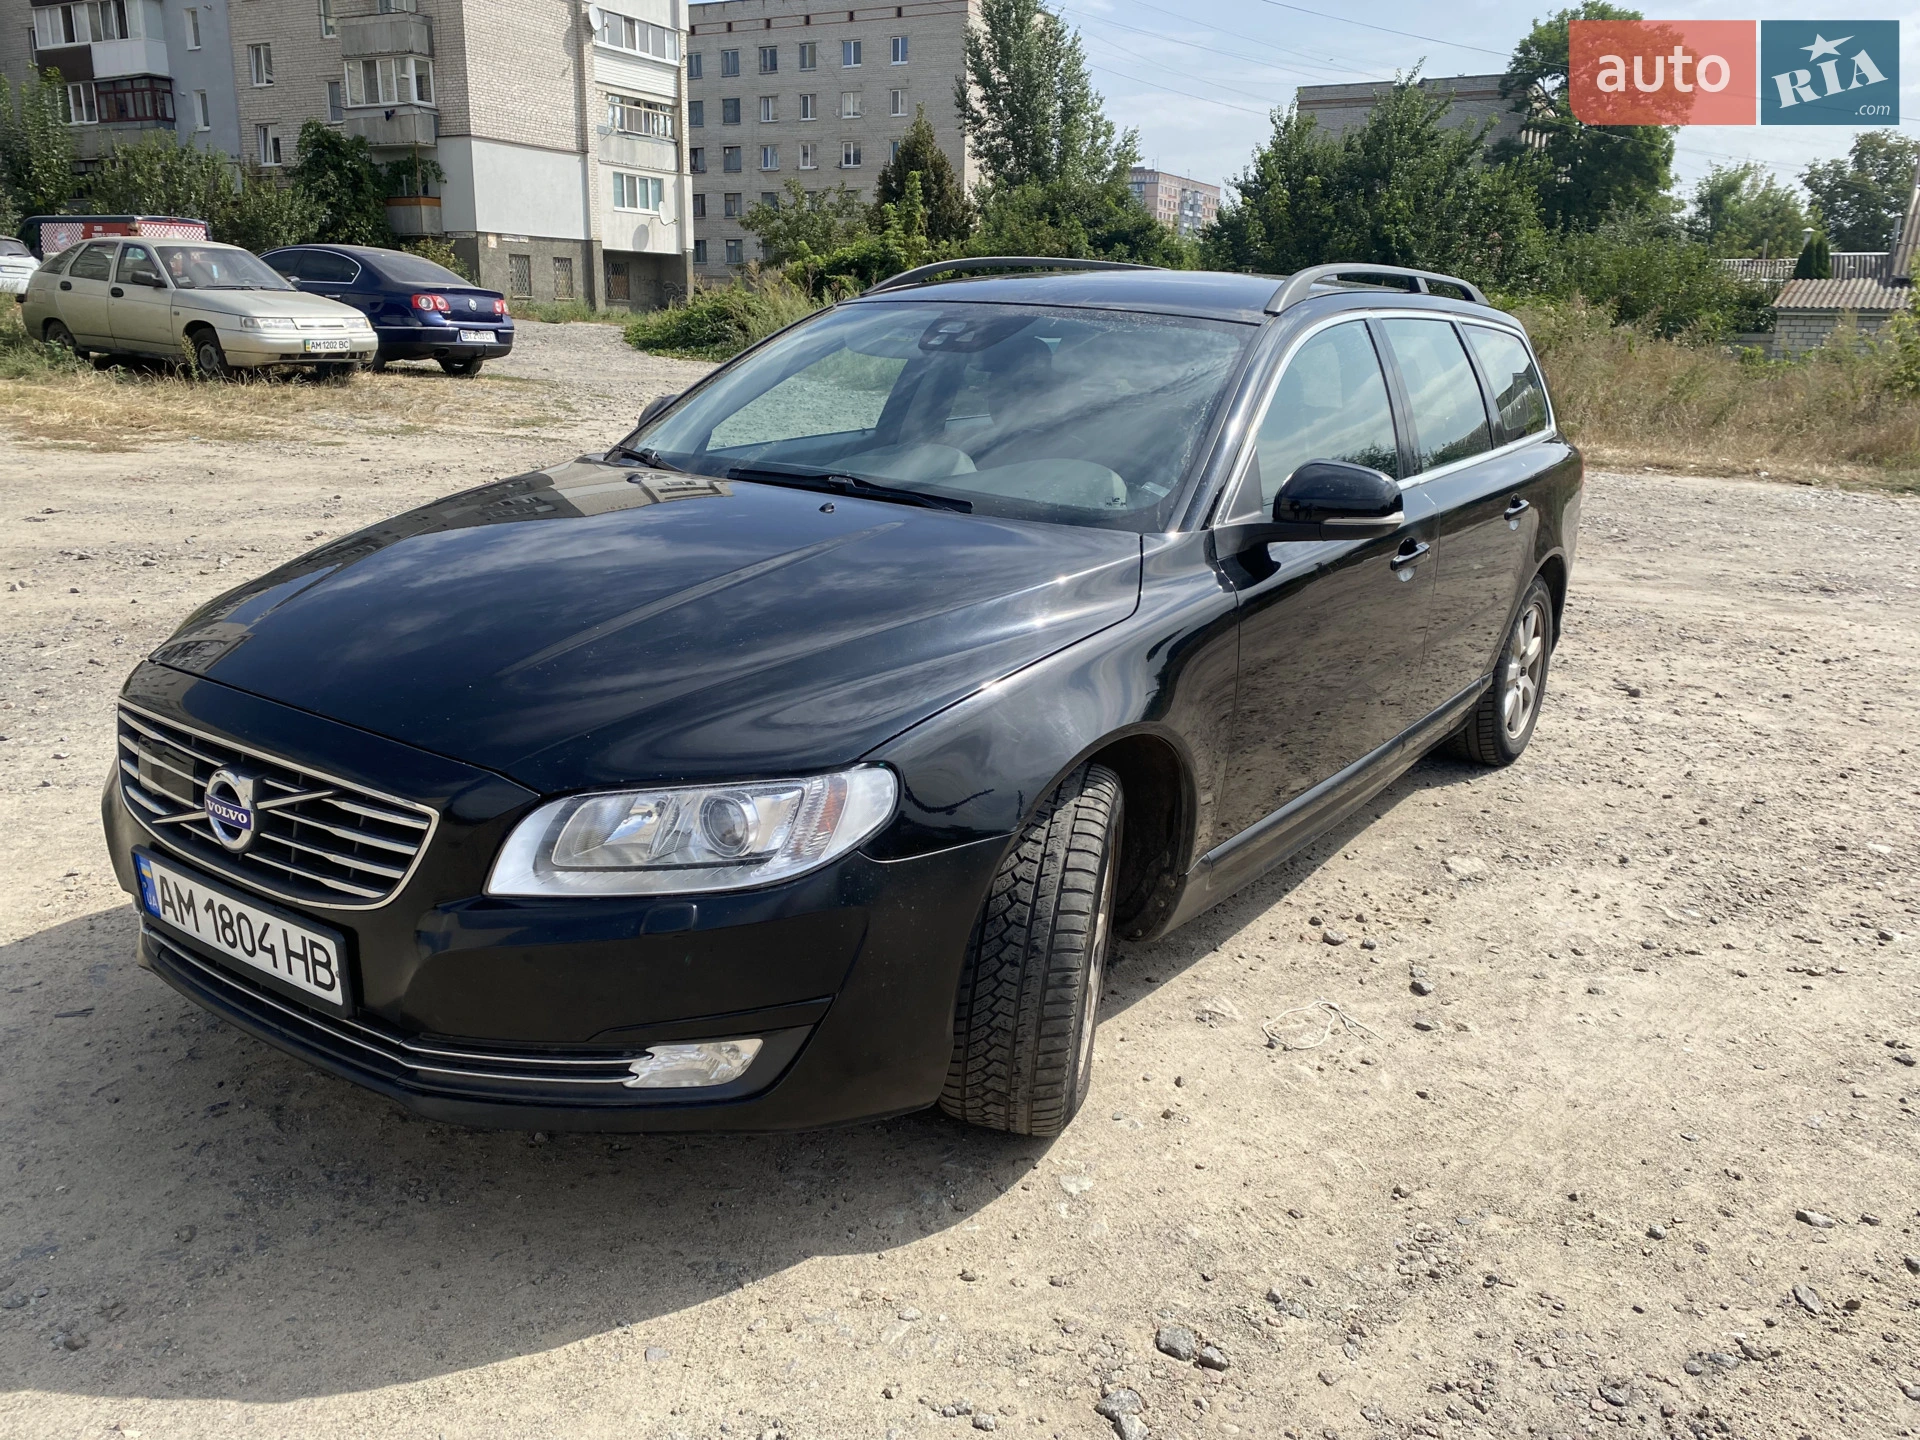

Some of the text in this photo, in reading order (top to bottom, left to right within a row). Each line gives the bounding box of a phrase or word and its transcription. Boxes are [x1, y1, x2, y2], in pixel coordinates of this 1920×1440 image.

[311, 341, 348, 349] AM 1202 BC
[206, 800, 248, 824] VOLVO
[159, 874, 337, 993] AM 1804 HB
